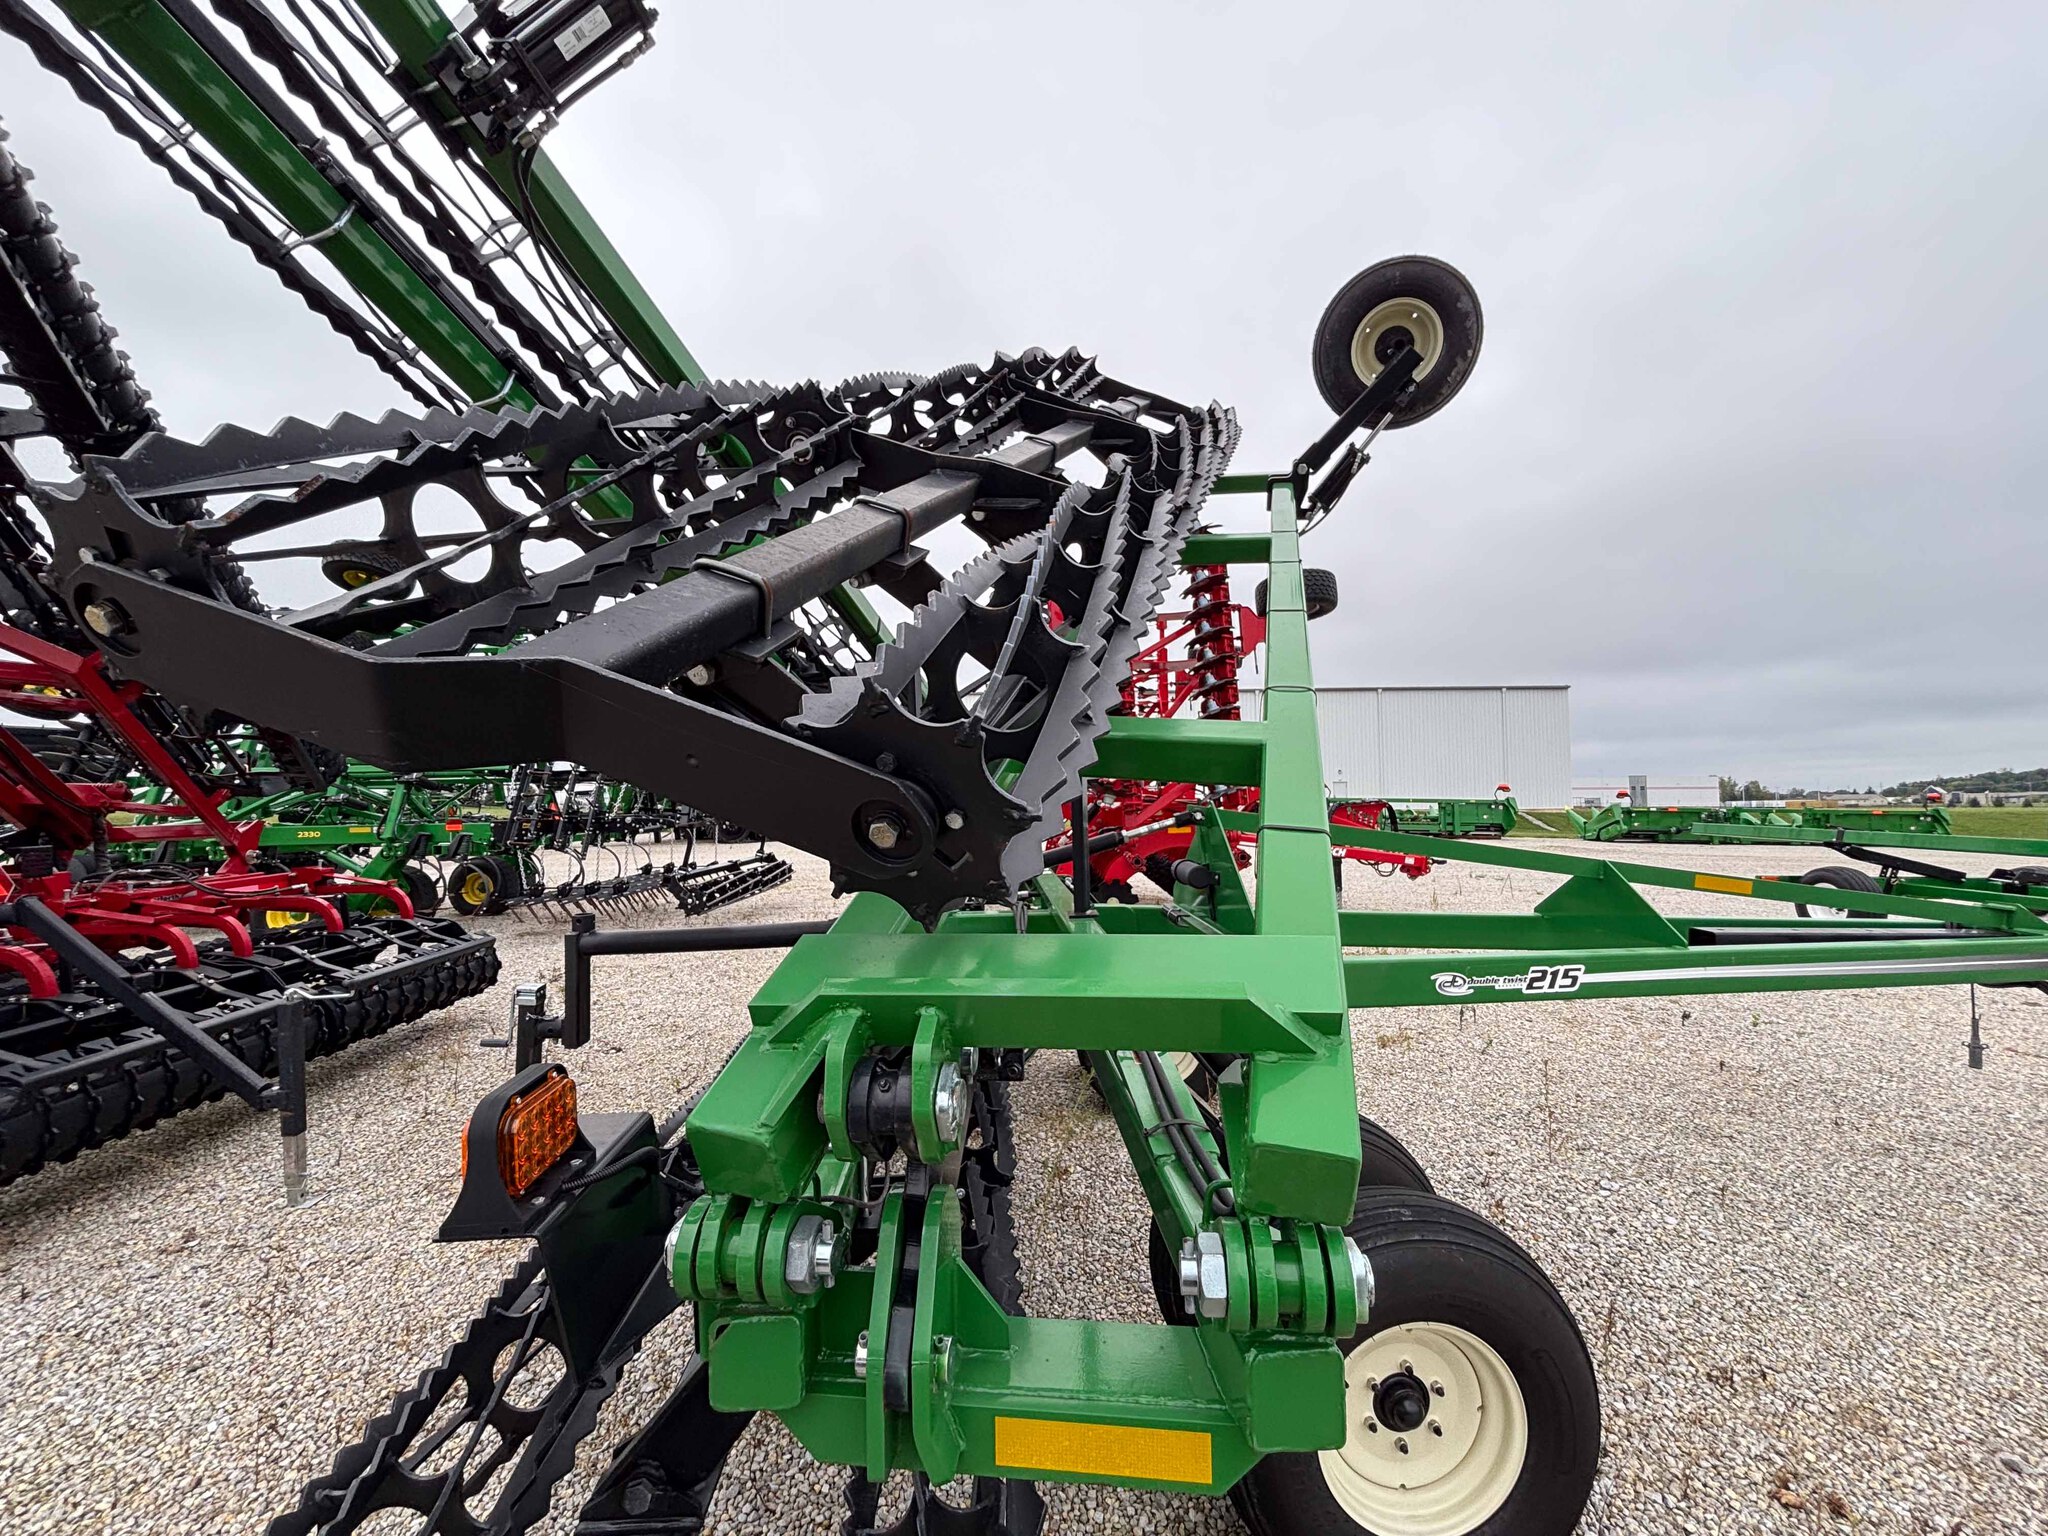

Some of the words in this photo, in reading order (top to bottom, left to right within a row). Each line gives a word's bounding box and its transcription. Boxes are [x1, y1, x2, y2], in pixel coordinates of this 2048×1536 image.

[1331, 847, 1347, 857] CH
[1467, 976, 1500, 985] double
[1503, 976, 1528, 984] twist
[1525, 967, 1582, 990] 215
